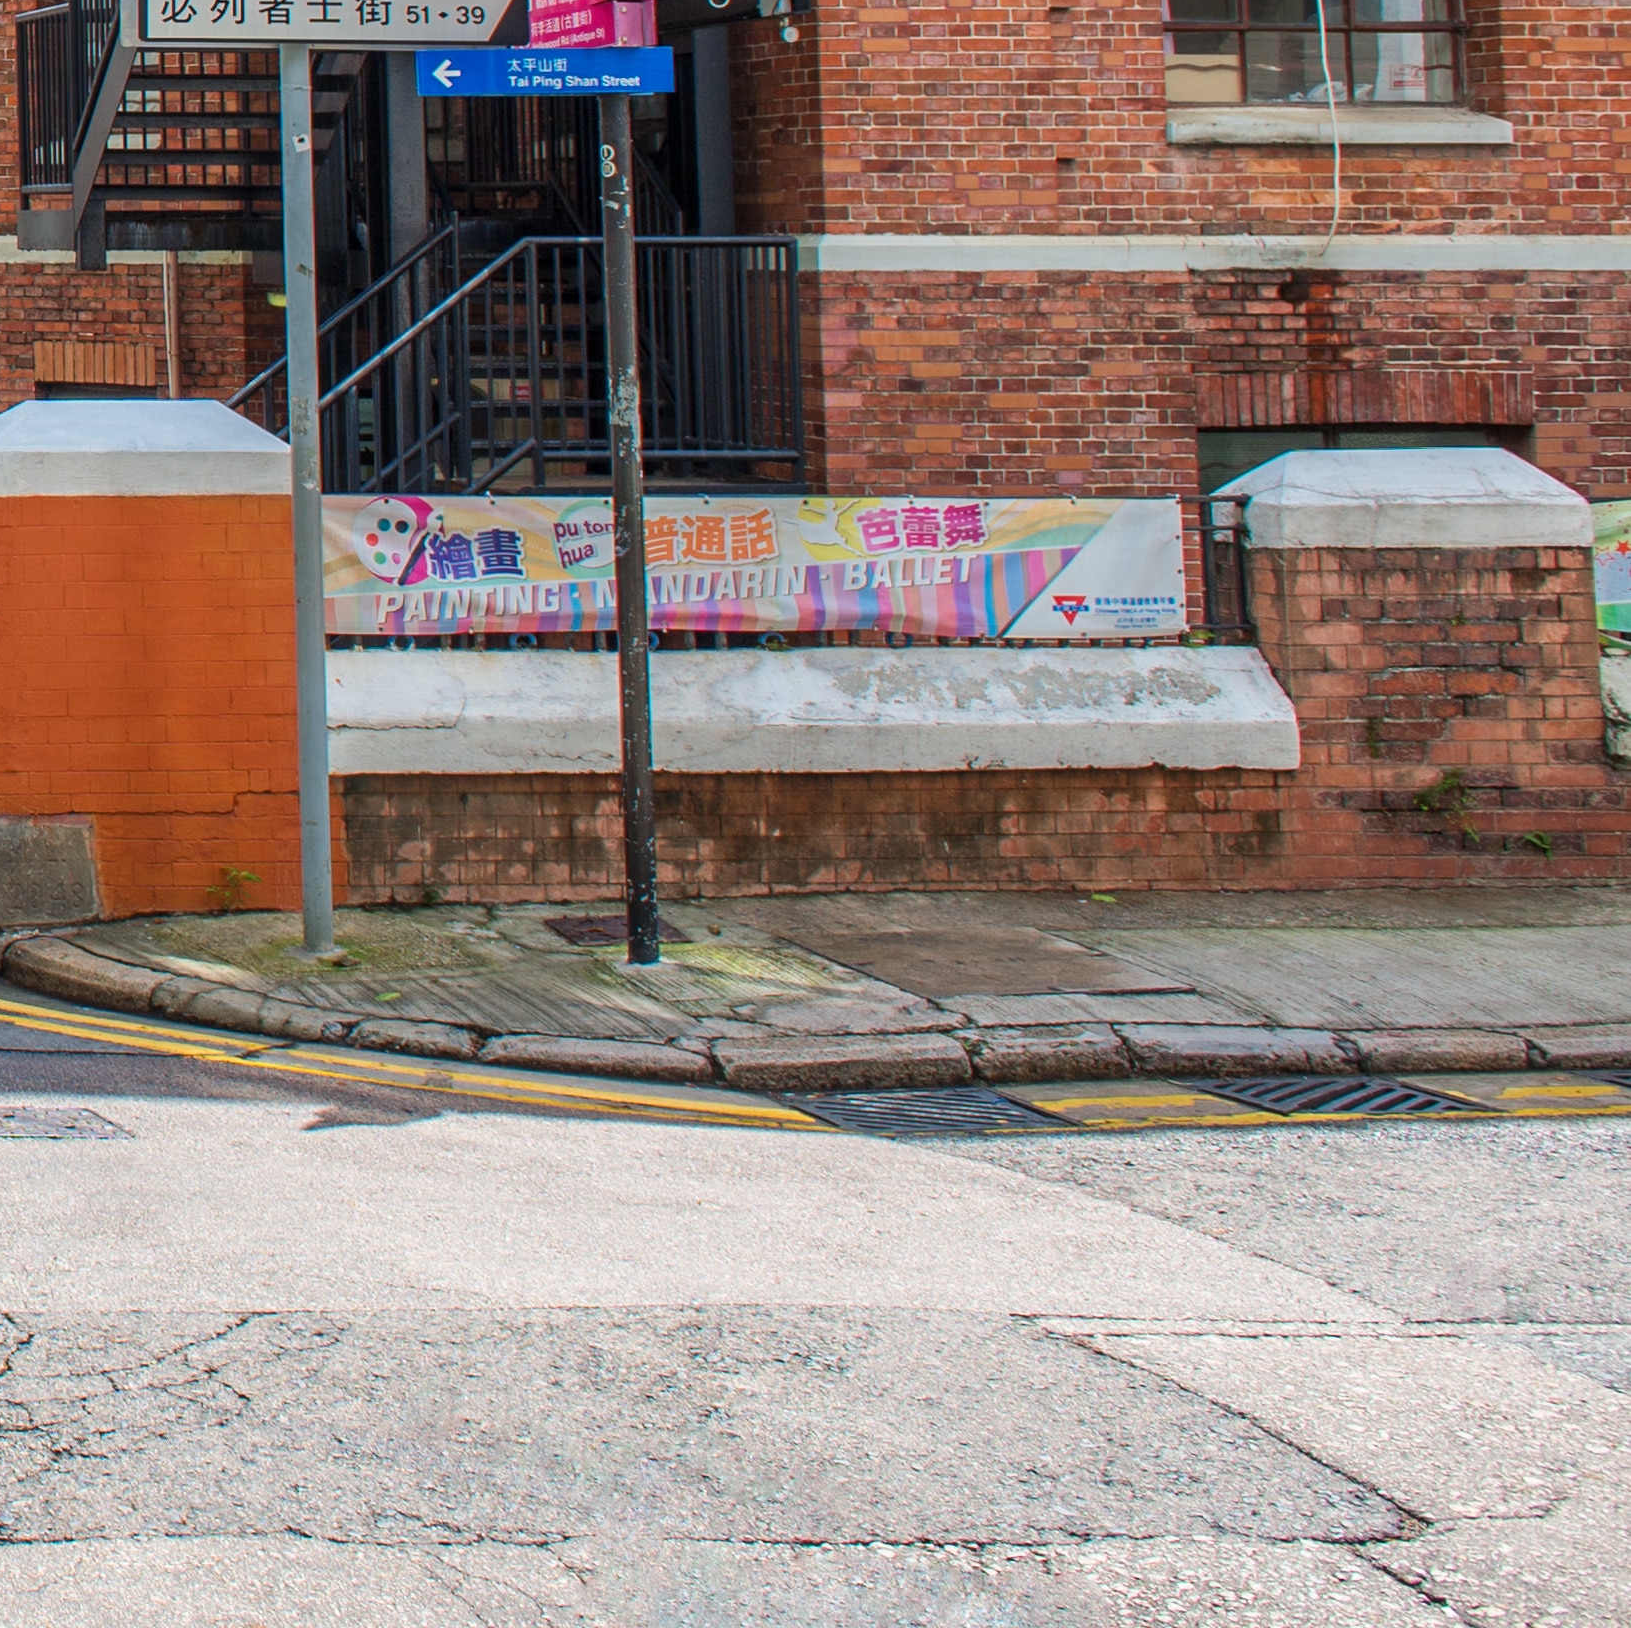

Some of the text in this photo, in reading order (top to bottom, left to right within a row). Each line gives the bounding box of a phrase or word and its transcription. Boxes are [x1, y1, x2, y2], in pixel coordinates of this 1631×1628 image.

[405, 5, 429, 24] 51
[456, 5, 485, 24] 39
[560, 36, 570, 46] Rd
[507, 57, 567, 73] 太平山街
[508, 75, 641, 89] Tai Ping Shan Street
[553, 519, 615, 543] pu ton
[644, 508, 777, 566] 普通話
[857, 503, 986, 551] 芭蕾舞
[428, 528, 524, 579] 繪畫
[558, 543, 595, 569] hua
[376, 582, 561, 624] PAINTING
[843, 553, 978, 591] BALLET
